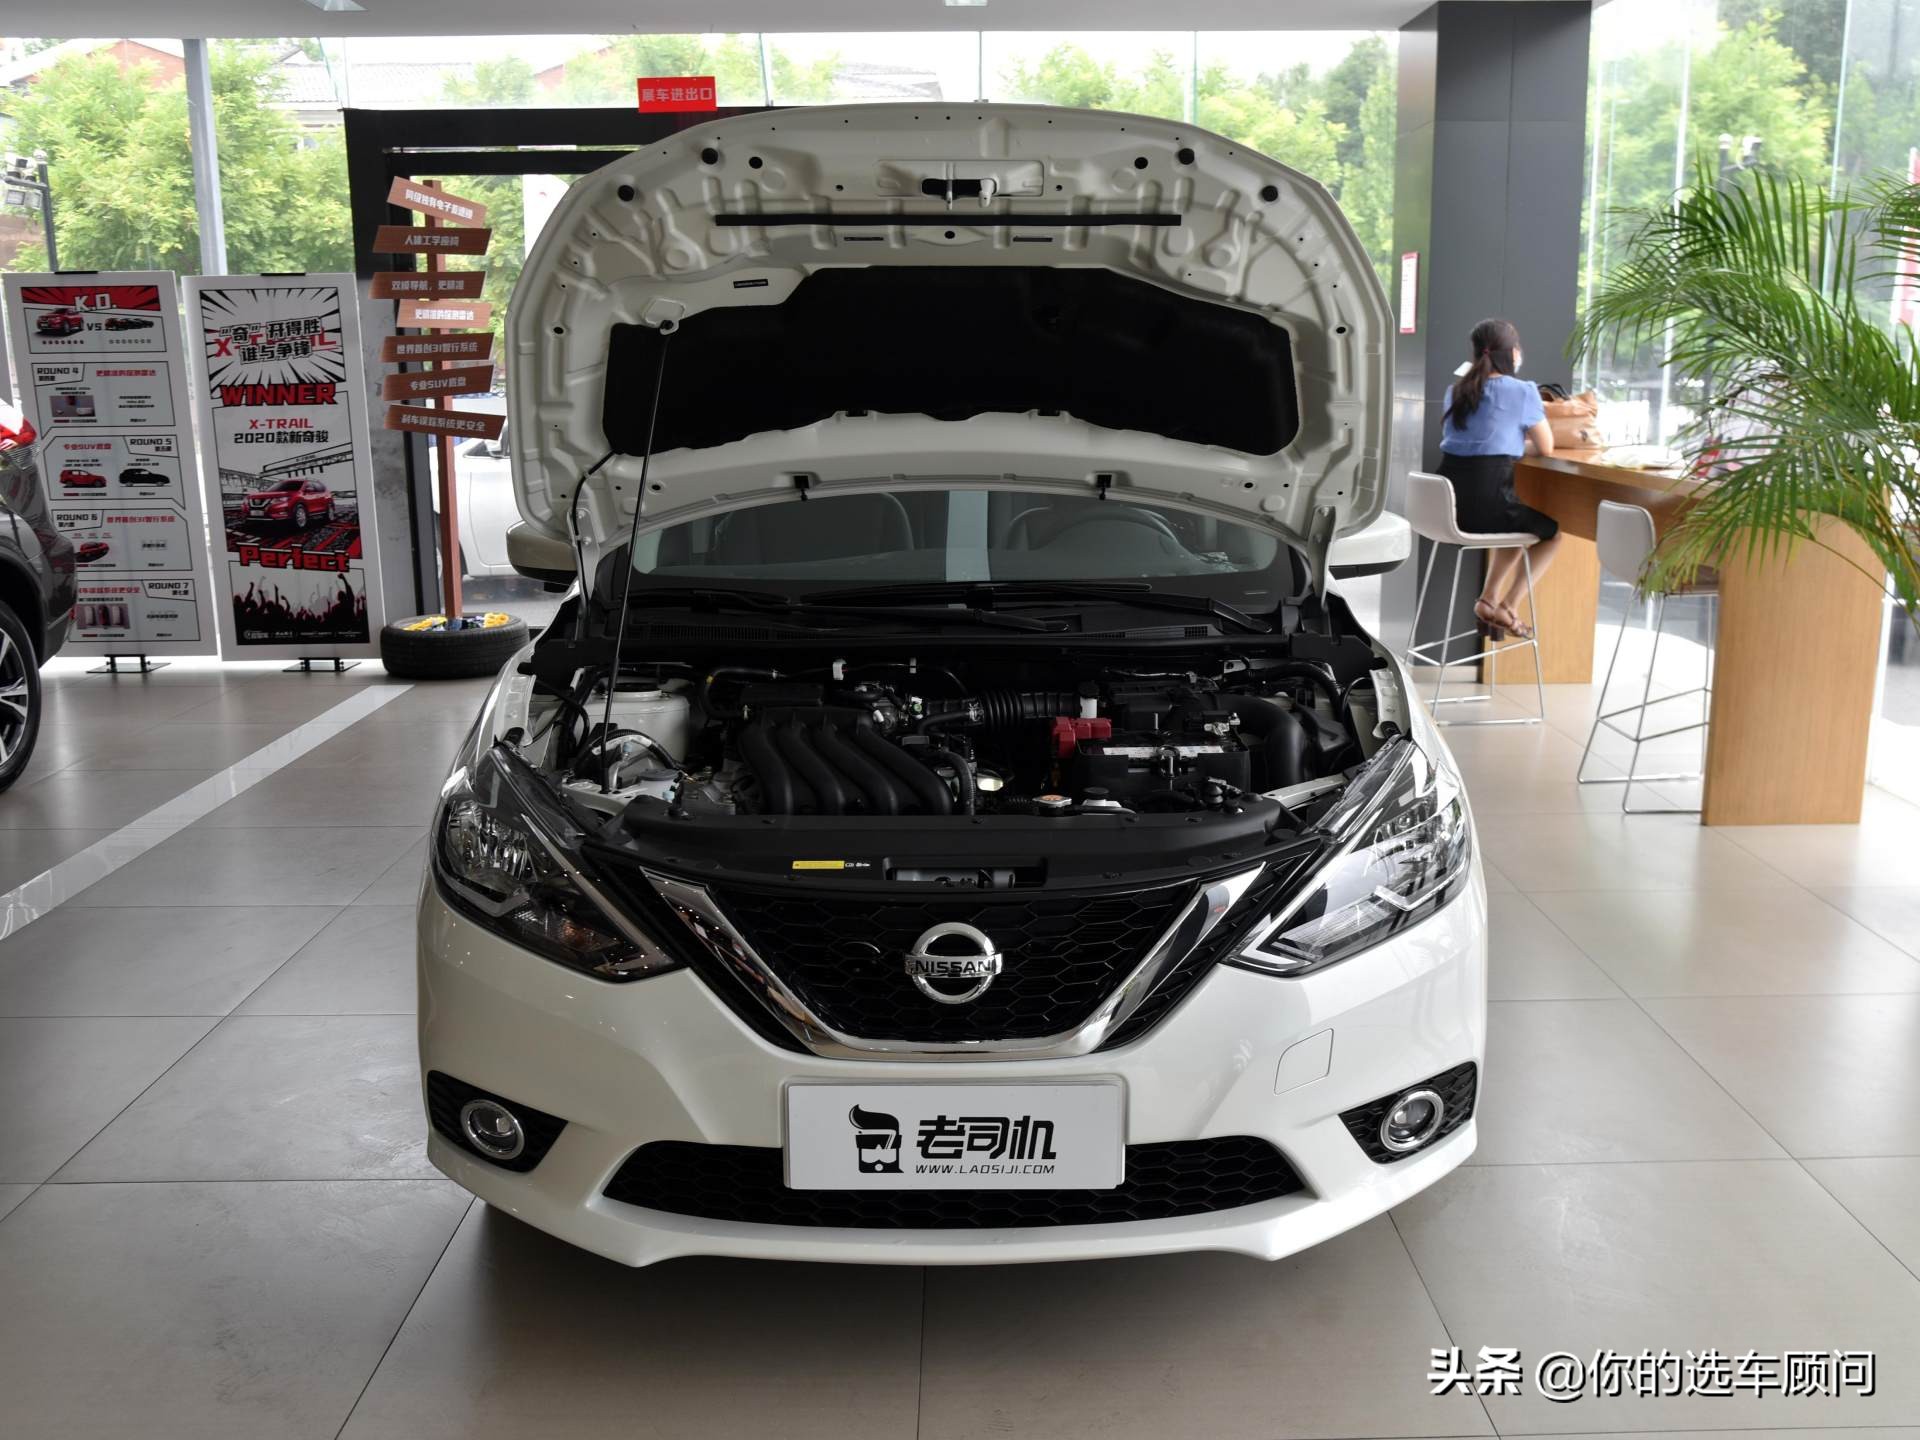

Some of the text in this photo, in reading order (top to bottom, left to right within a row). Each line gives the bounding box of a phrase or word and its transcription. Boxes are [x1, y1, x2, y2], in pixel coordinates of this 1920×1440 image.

[642, 87, 712, 102] 展车进出口
[86, 323, 102, 331] VS
[242, 341, 311, 362] 谁与争锋
[37, 367, 70, 375] ROUND
[219, 383, 338, 407] WINNER
[250, 418, 314, 430] X-TRAIL
[129, 438, 162, 446] ROUND
[234, 431, 329, 445] 2020款新奇骏
[56, 513, 98, 521] ROUND 6
[239, 546, 350, 573] Perfect
[915, 960, 992, 974] NISSAN
[916, 1115, 1057, 1160] 老司机
[915, 1164, 1056, 1175] WWW.LAOSIJI.COM
